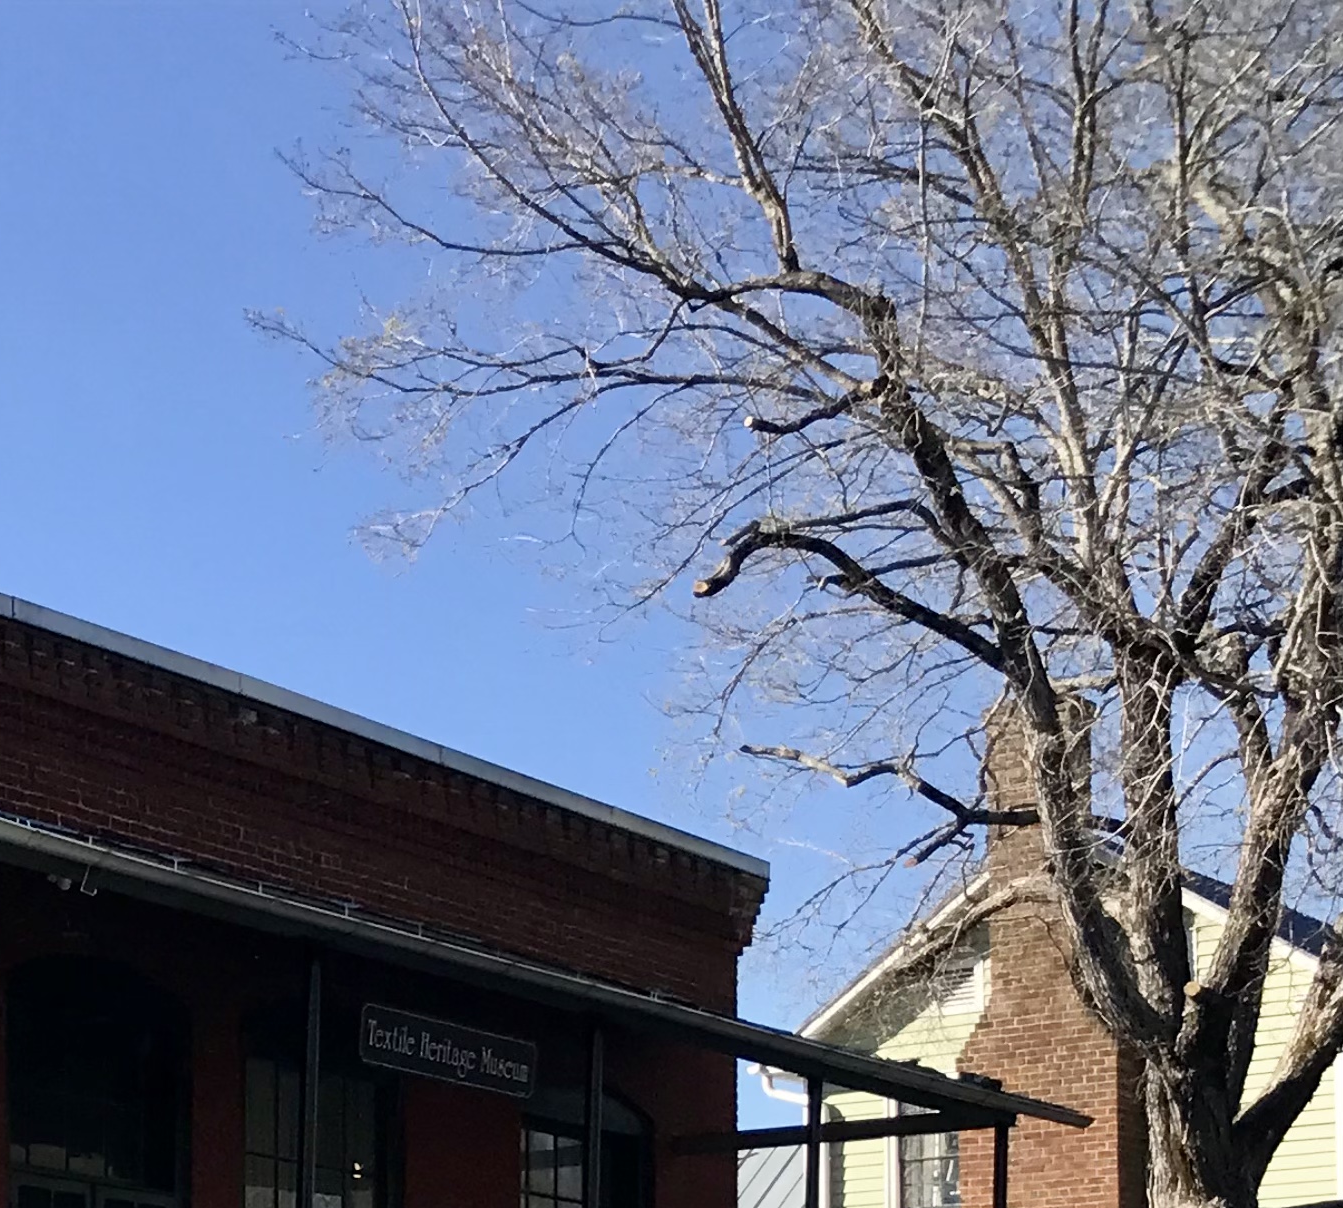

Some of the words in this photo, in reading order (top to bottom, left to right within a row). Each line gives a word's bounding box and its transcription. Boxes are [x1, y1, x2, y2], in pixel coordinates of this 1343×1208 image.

[368, 1019, 415, 1056] Textile
[420, 1031, 476, 1078] Heritage
[480, 1046, 529, 1082] Museum
